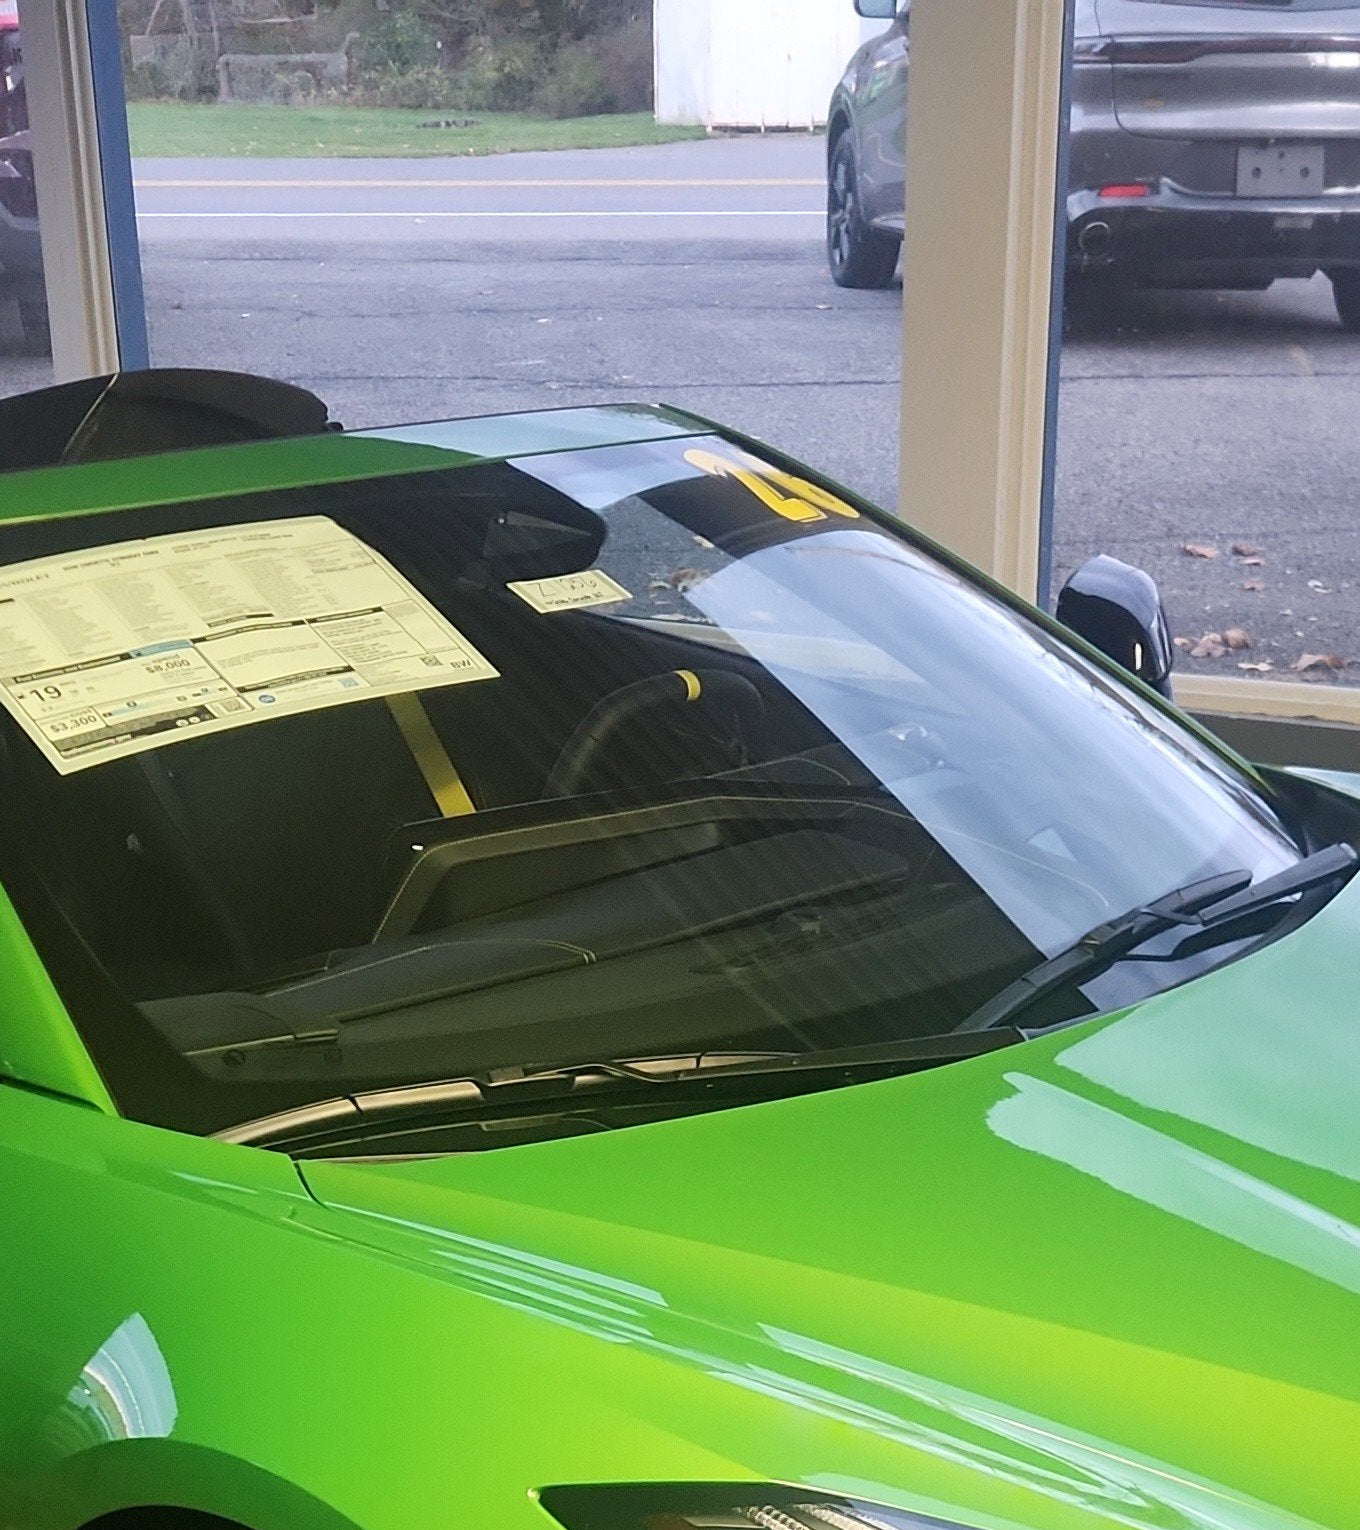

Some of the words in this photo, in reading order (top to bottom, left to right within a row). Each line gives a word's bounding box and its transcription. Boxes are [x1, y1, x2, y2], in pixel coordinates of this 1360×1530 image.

[145, 659, 191, 674] $8,000
[450, 658, 473, 670] BW
[29, 685, 63, 704] 19
[49, 713, 98, 734] $3,300
